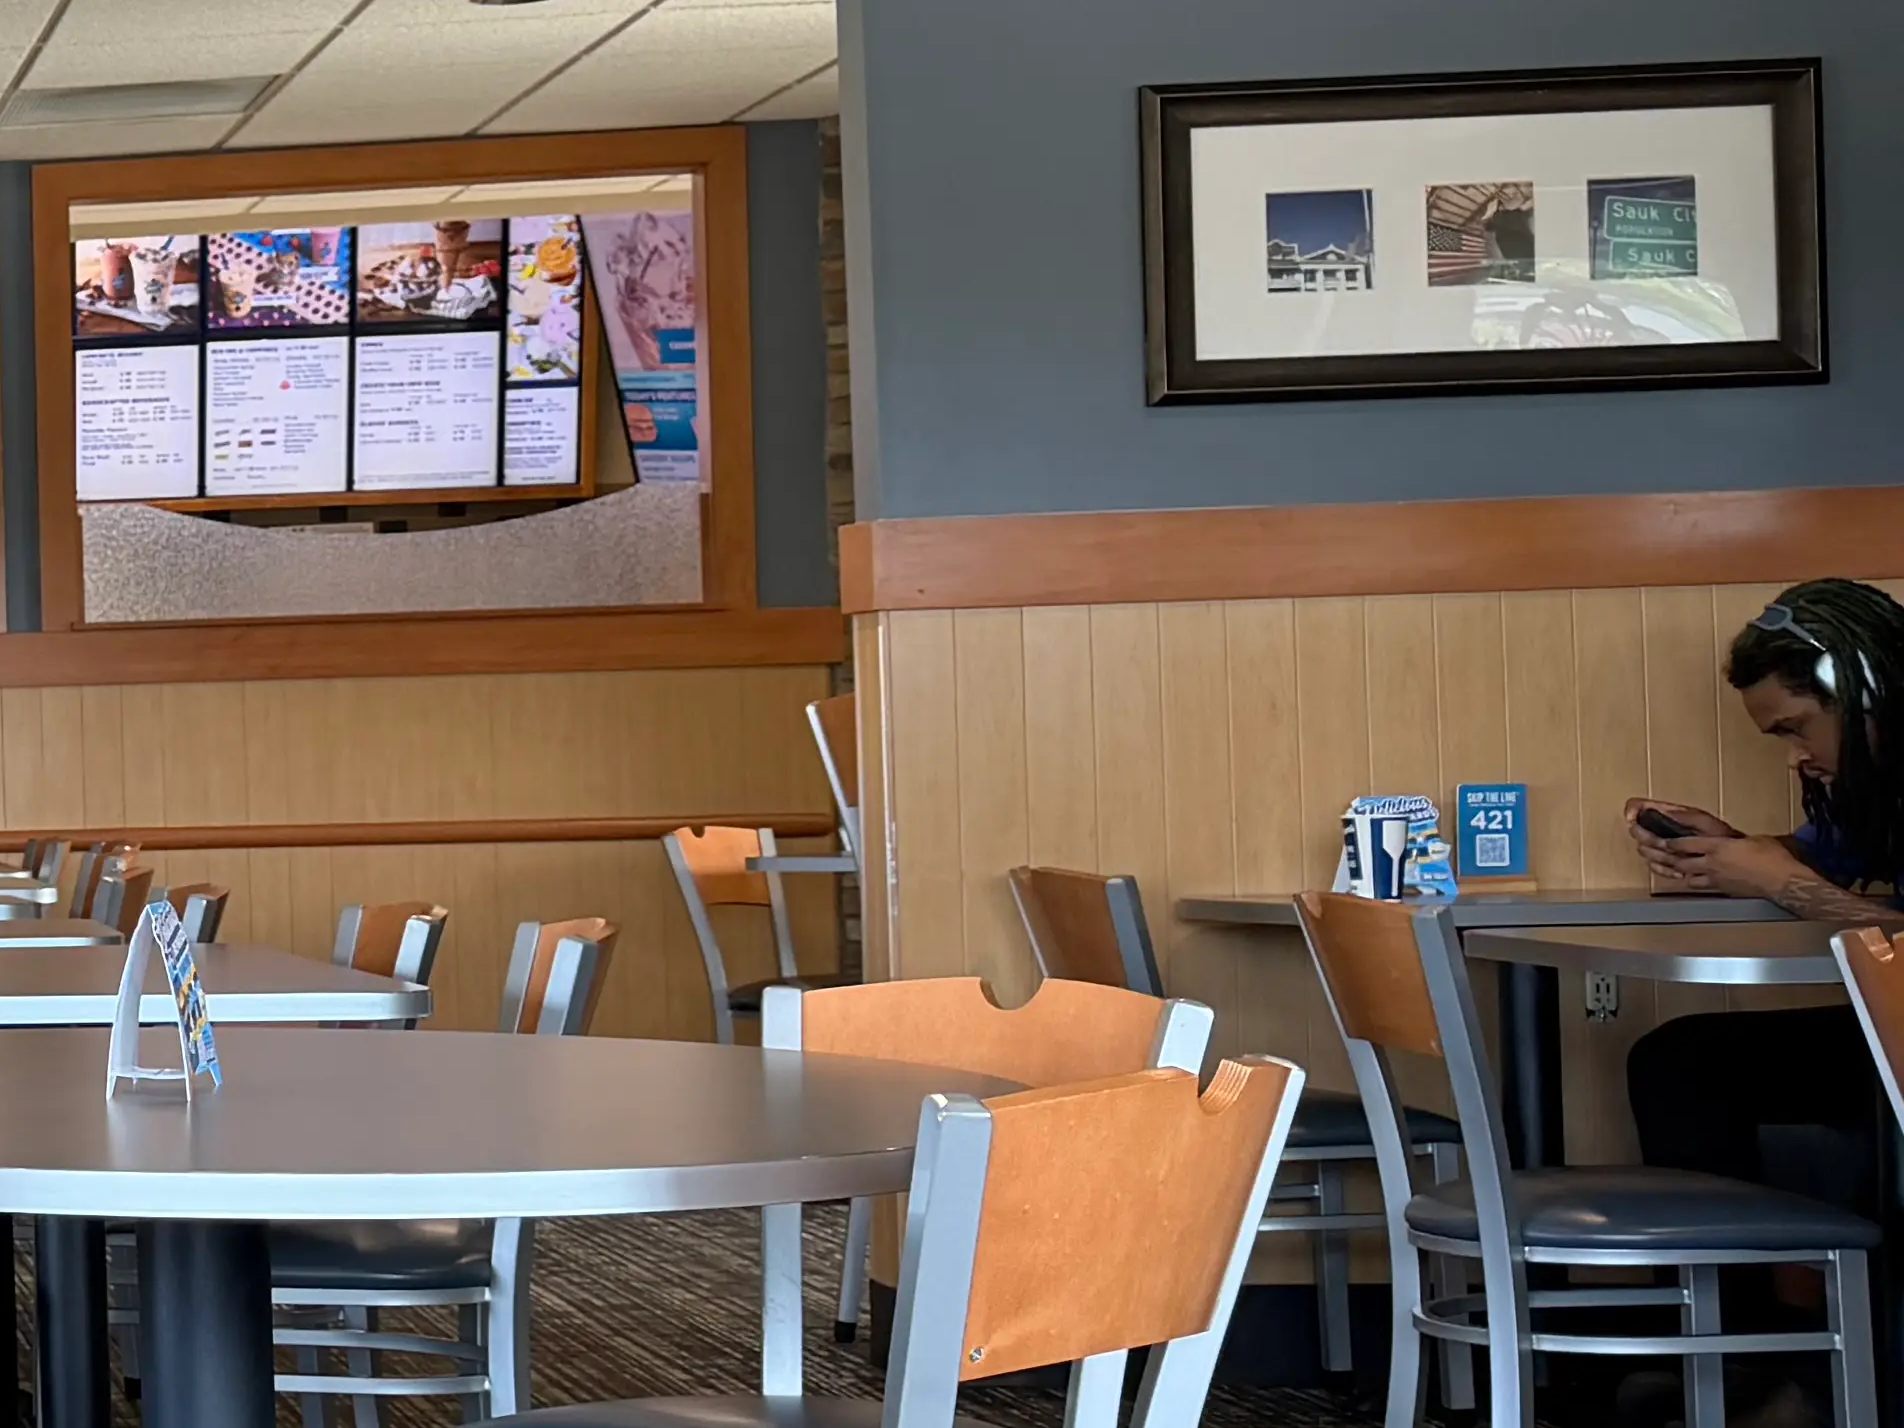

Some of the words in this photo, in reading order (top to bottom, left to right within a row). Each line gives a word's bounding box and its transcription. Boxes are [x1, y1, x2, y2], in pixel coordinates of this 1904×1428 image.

[1612, 202, 1660, 221] Sauk
[1627, 247, 1676, 263] Sauk
[1467, 792, 1484, 803] SKIP
[1485, 792, 1499, 802] THE
[1470, 810, 1513, 830] 421
